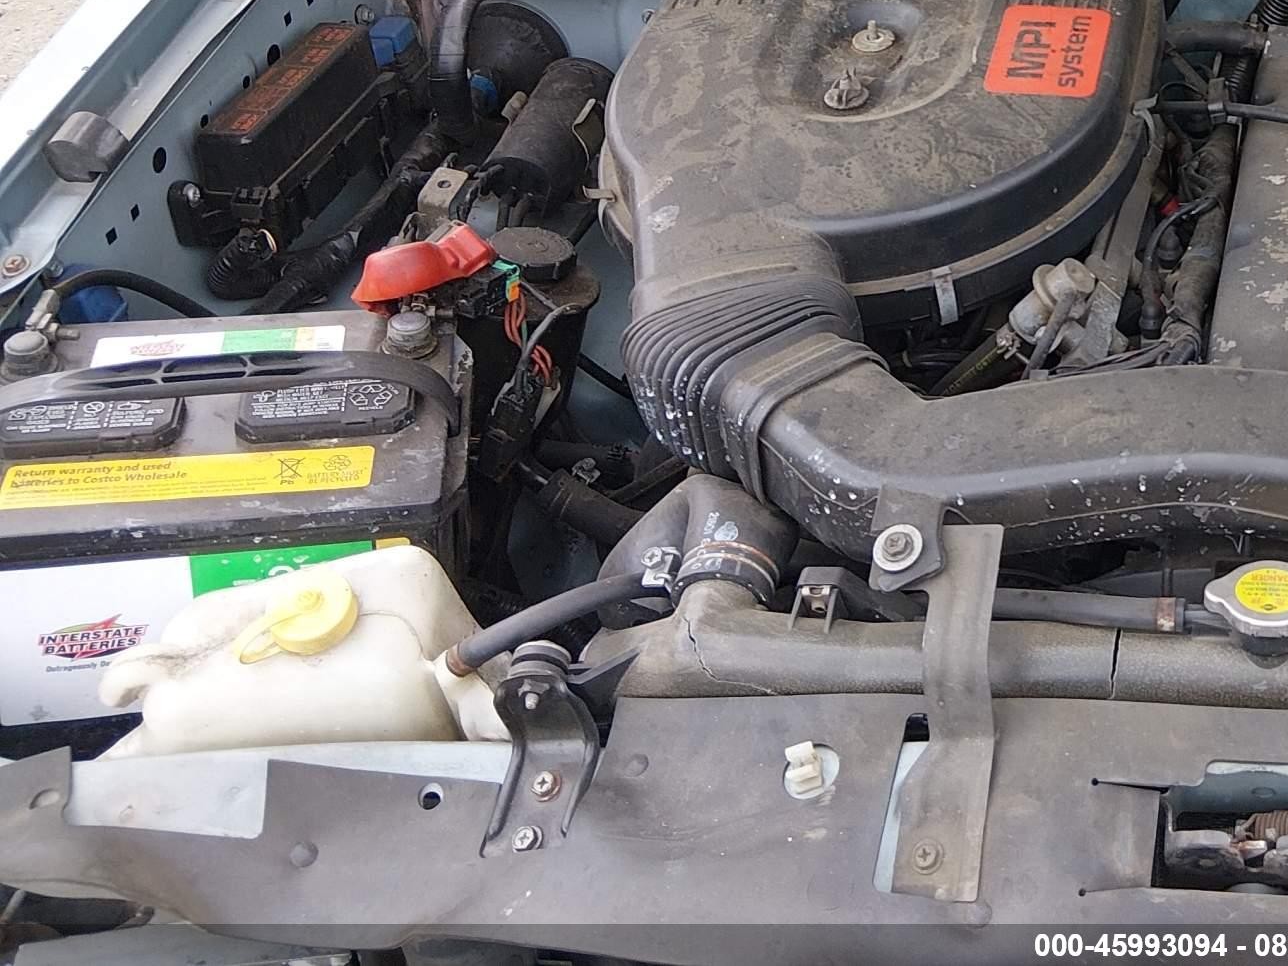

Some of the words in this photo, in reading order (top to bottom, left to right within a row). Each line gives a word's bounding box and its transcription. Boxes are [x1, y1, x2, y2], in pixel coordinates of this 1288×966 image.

[1006, 21, 1056, 78] MPI
[1058, 16, 1092, 88] system
[14, 469, 56, 478] Return
[59, 465, 112, 476] warranty
[115, 463, 140, 472] and
[143, 461, 171, 470] used
[67, 476, 80, 484] to
[82, 474, 122, 484] Costco
[124, 471, 188, 482] Wholesale
[39, 626, 145, 645] INTERSTATE
[43, 637, 137, 654] BATTERIES
